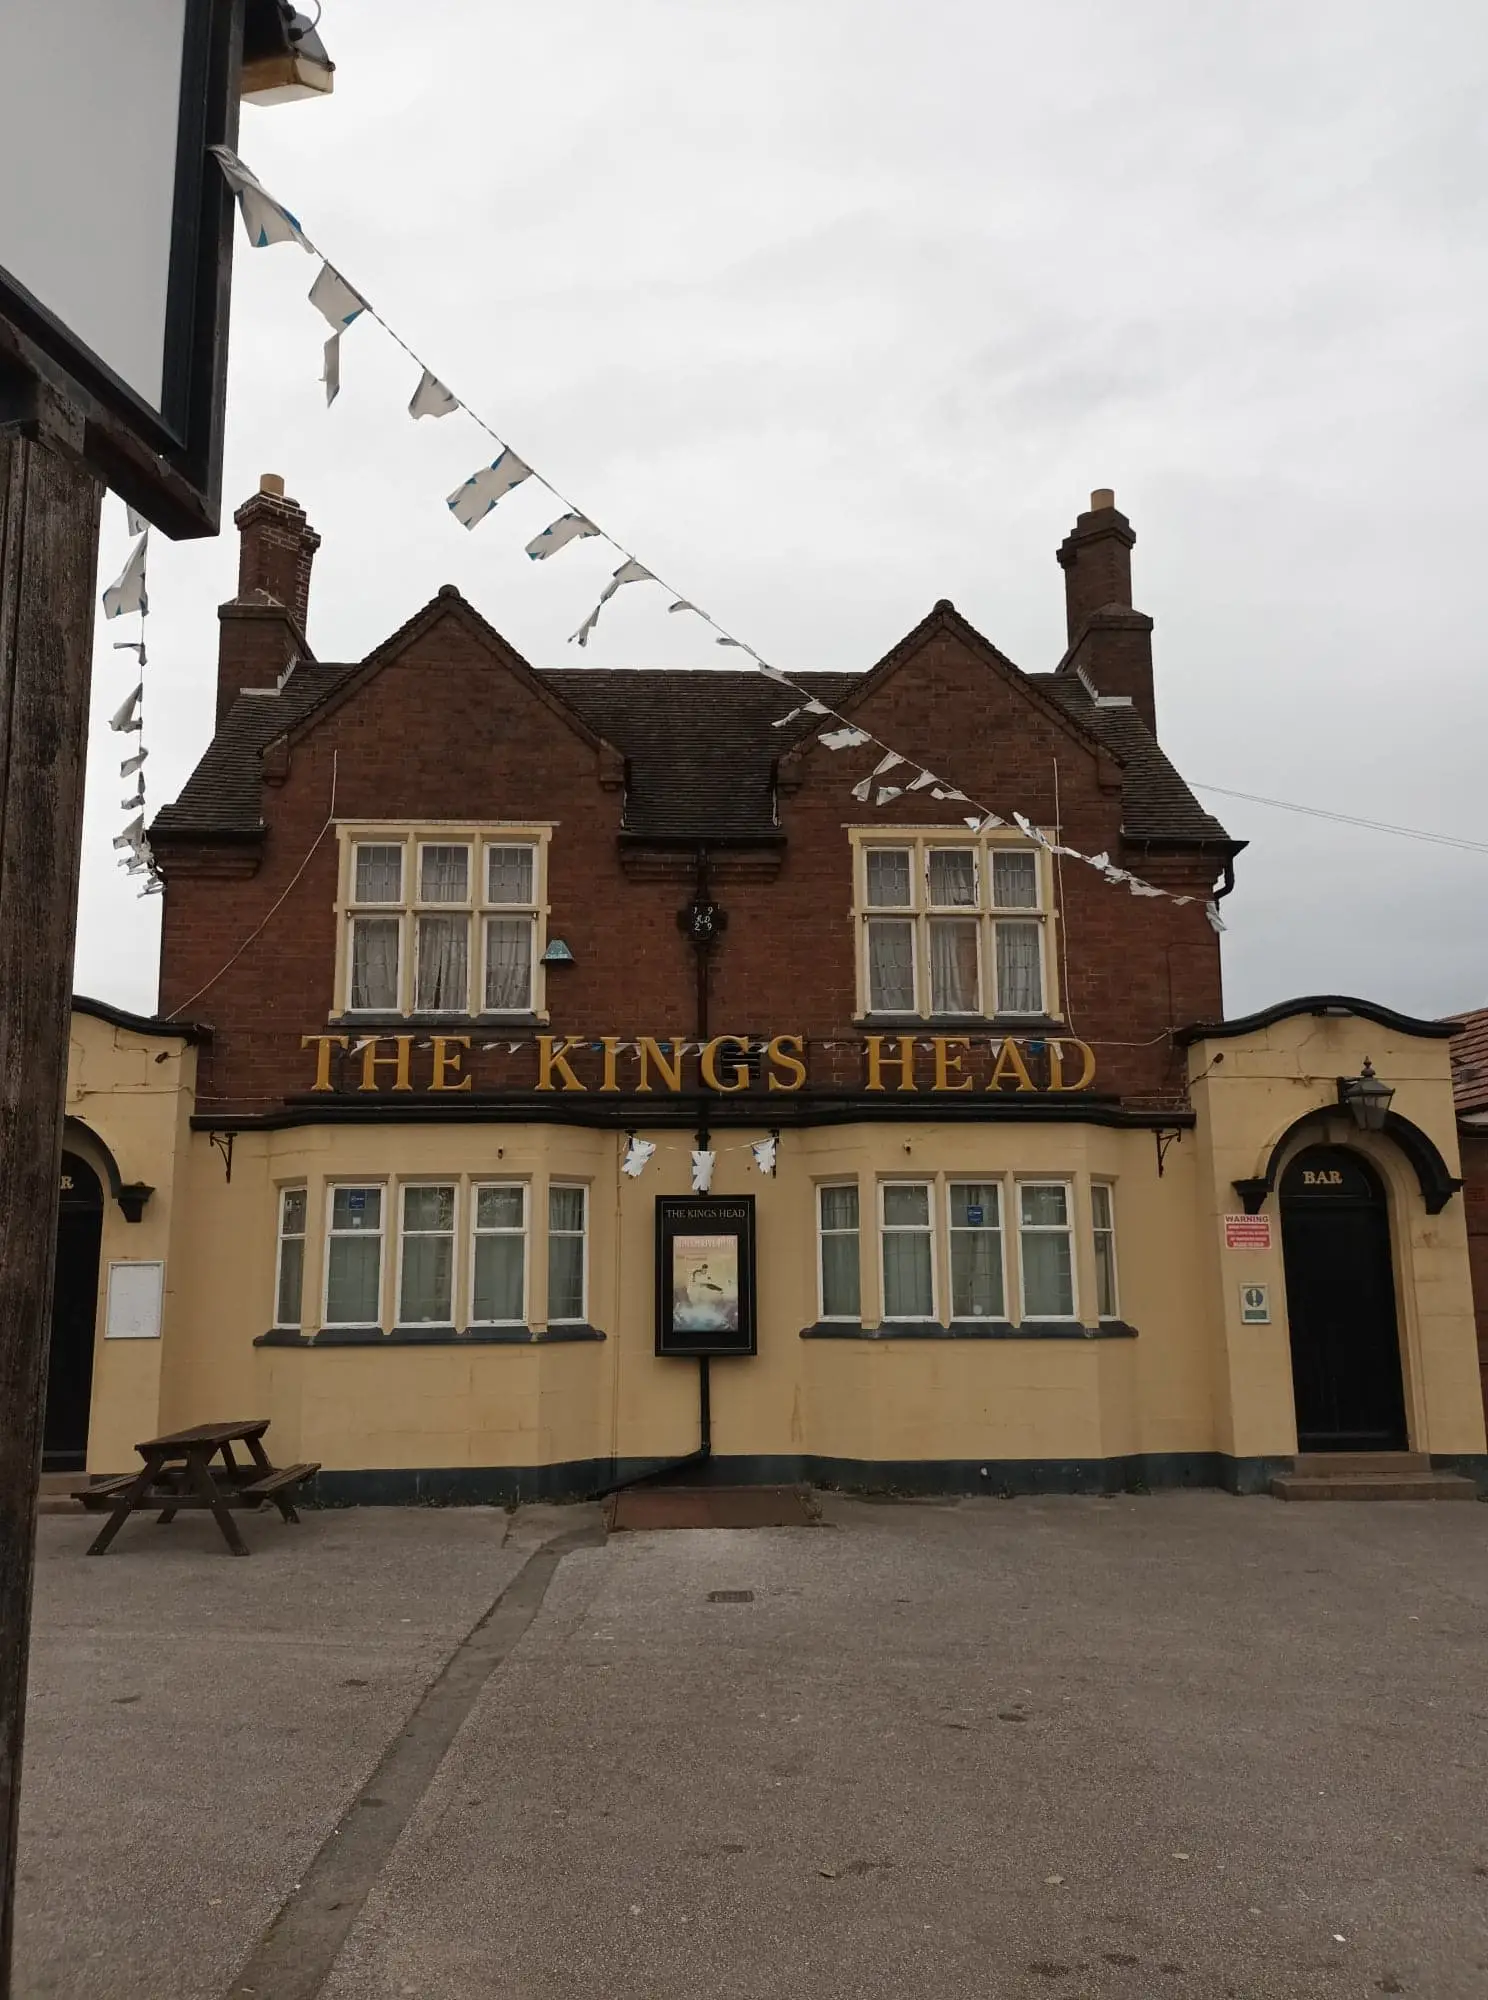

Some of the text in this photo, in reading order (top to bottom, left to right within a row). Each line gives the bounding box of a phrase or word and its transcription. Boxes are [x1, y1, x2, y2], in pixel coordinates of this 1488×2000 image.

[301, 1035, 1096, 1092] THE KINGS HEAD
[1303, 1171, 1343, 1184] BAR
[667, 1209, 745, 1218] THE KINGS HEAD
